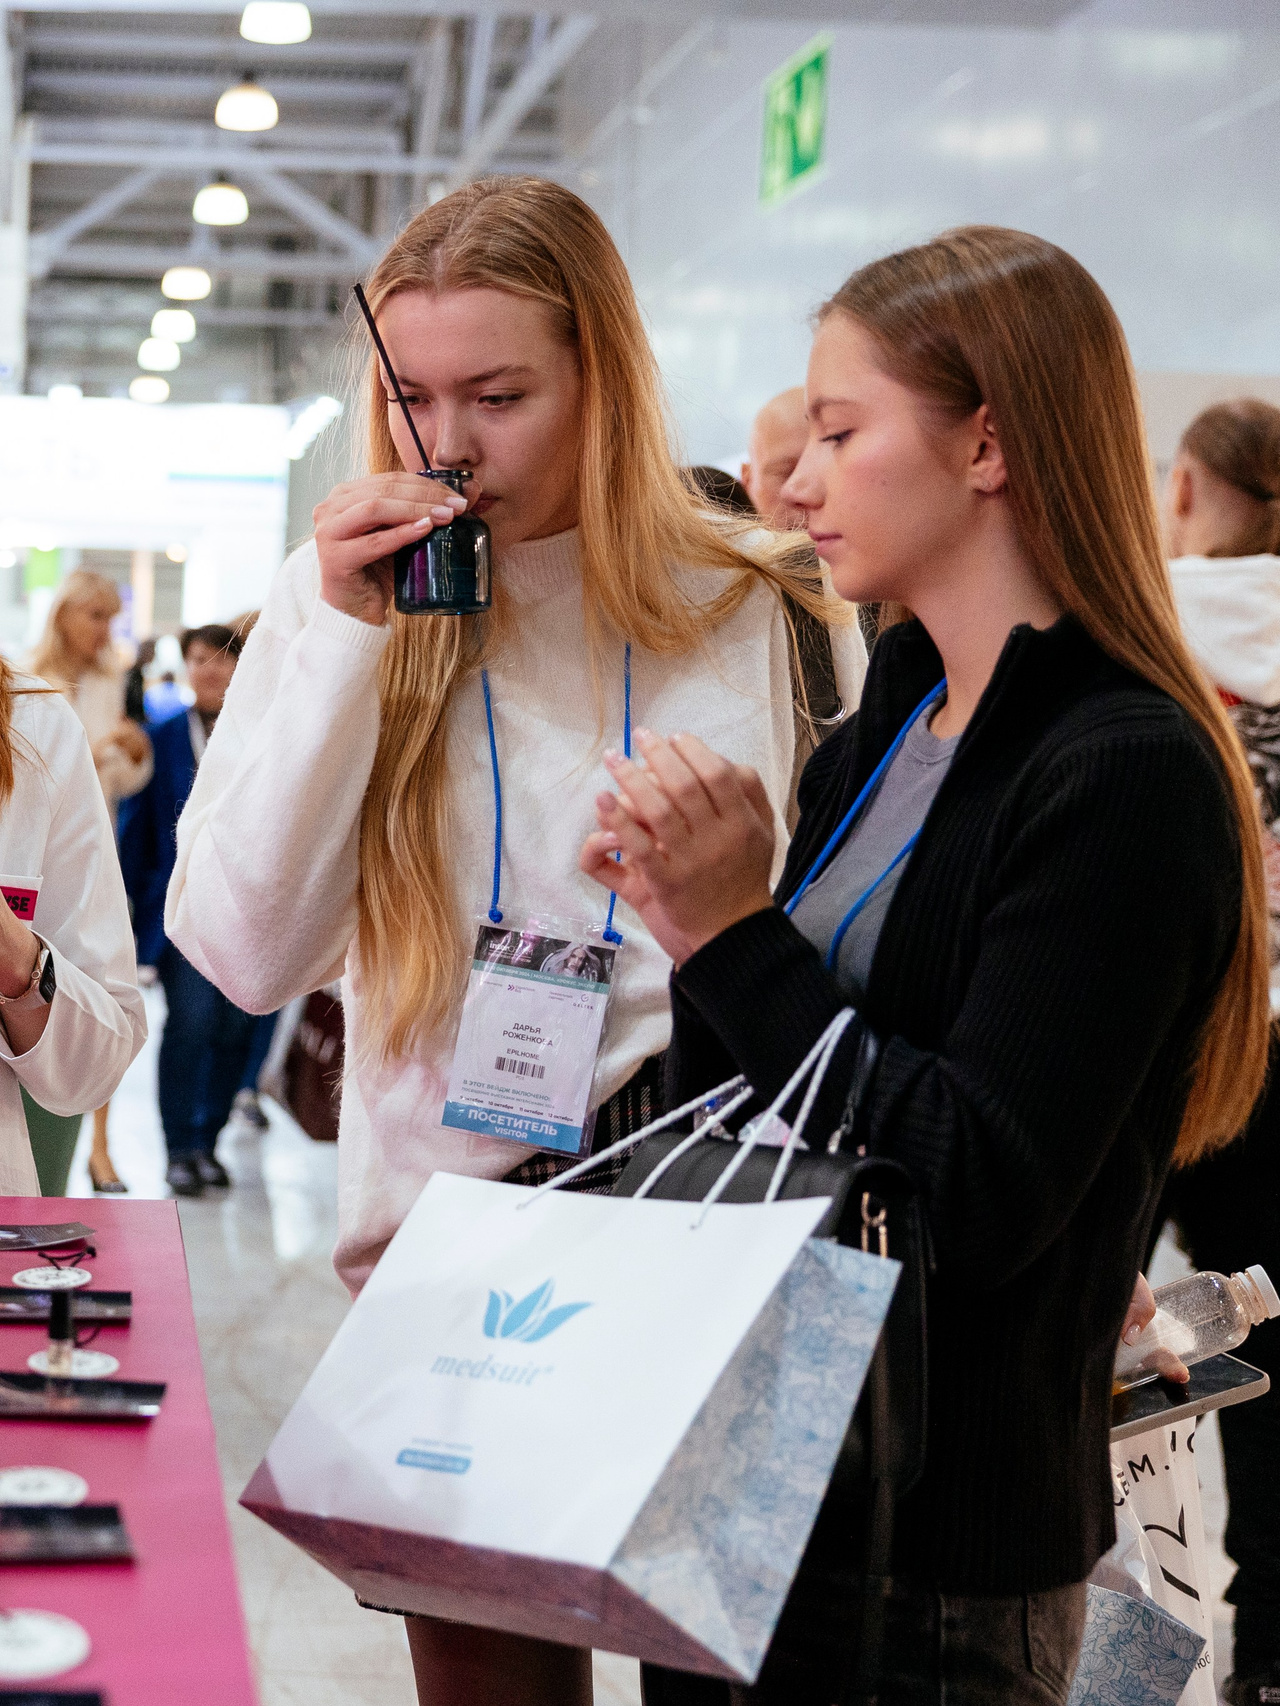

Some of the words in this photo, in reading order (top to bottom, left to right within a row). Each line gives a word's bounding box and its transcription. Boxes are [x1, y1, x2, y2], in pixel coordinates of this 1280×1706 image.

[513, 1023, 542, 1035] ДАРЬЯ
[468, 1109, 559, 1136] ПОСЕТИТЕЛЬ
[495, 1127, 528, 1139] VISITOR
